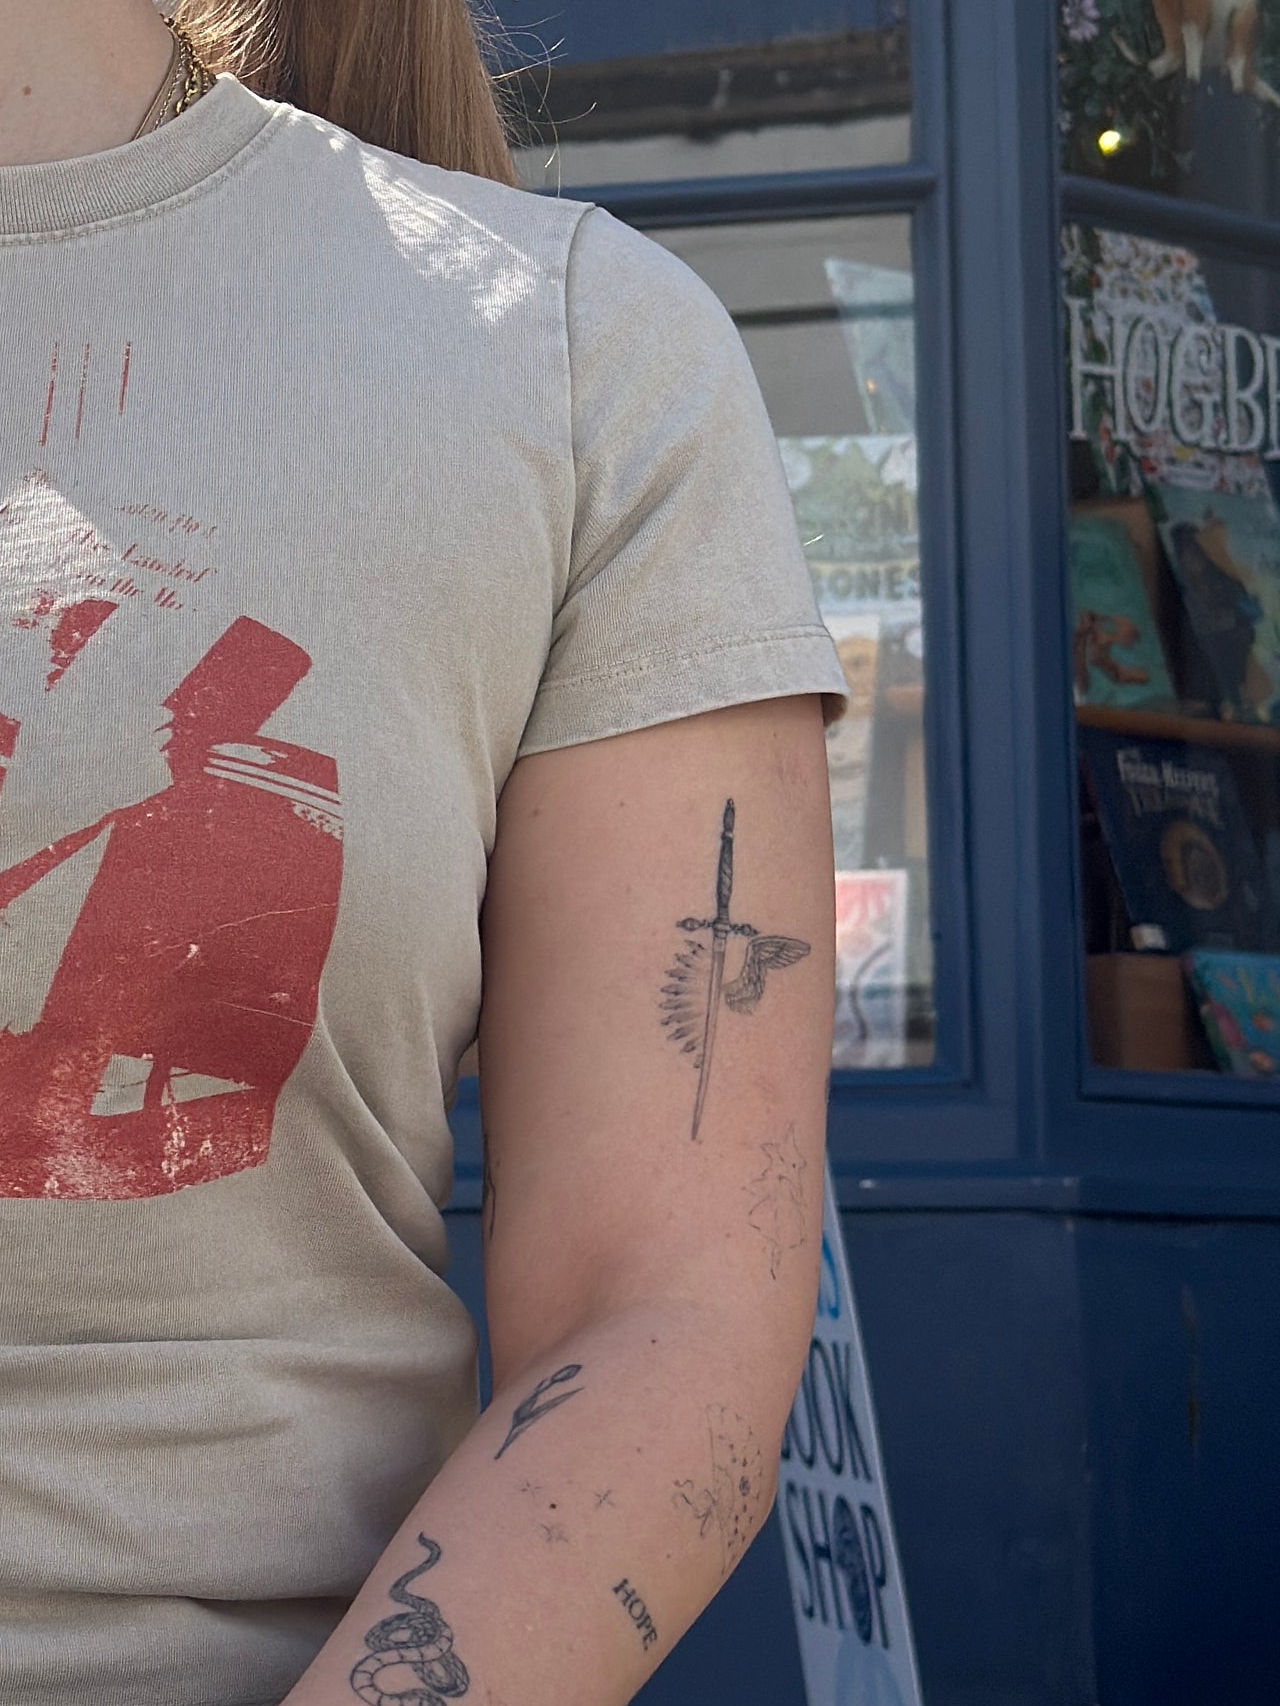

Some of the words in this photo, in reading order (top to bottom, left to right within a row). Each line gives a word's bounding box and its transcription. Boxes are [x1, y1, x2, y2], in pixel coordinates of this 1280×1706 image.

[781, 1339, 872, 1481] OOK
[613, 1579, 658, 1651] HOPE
[786, 1480, 890, 1650] SHOP
